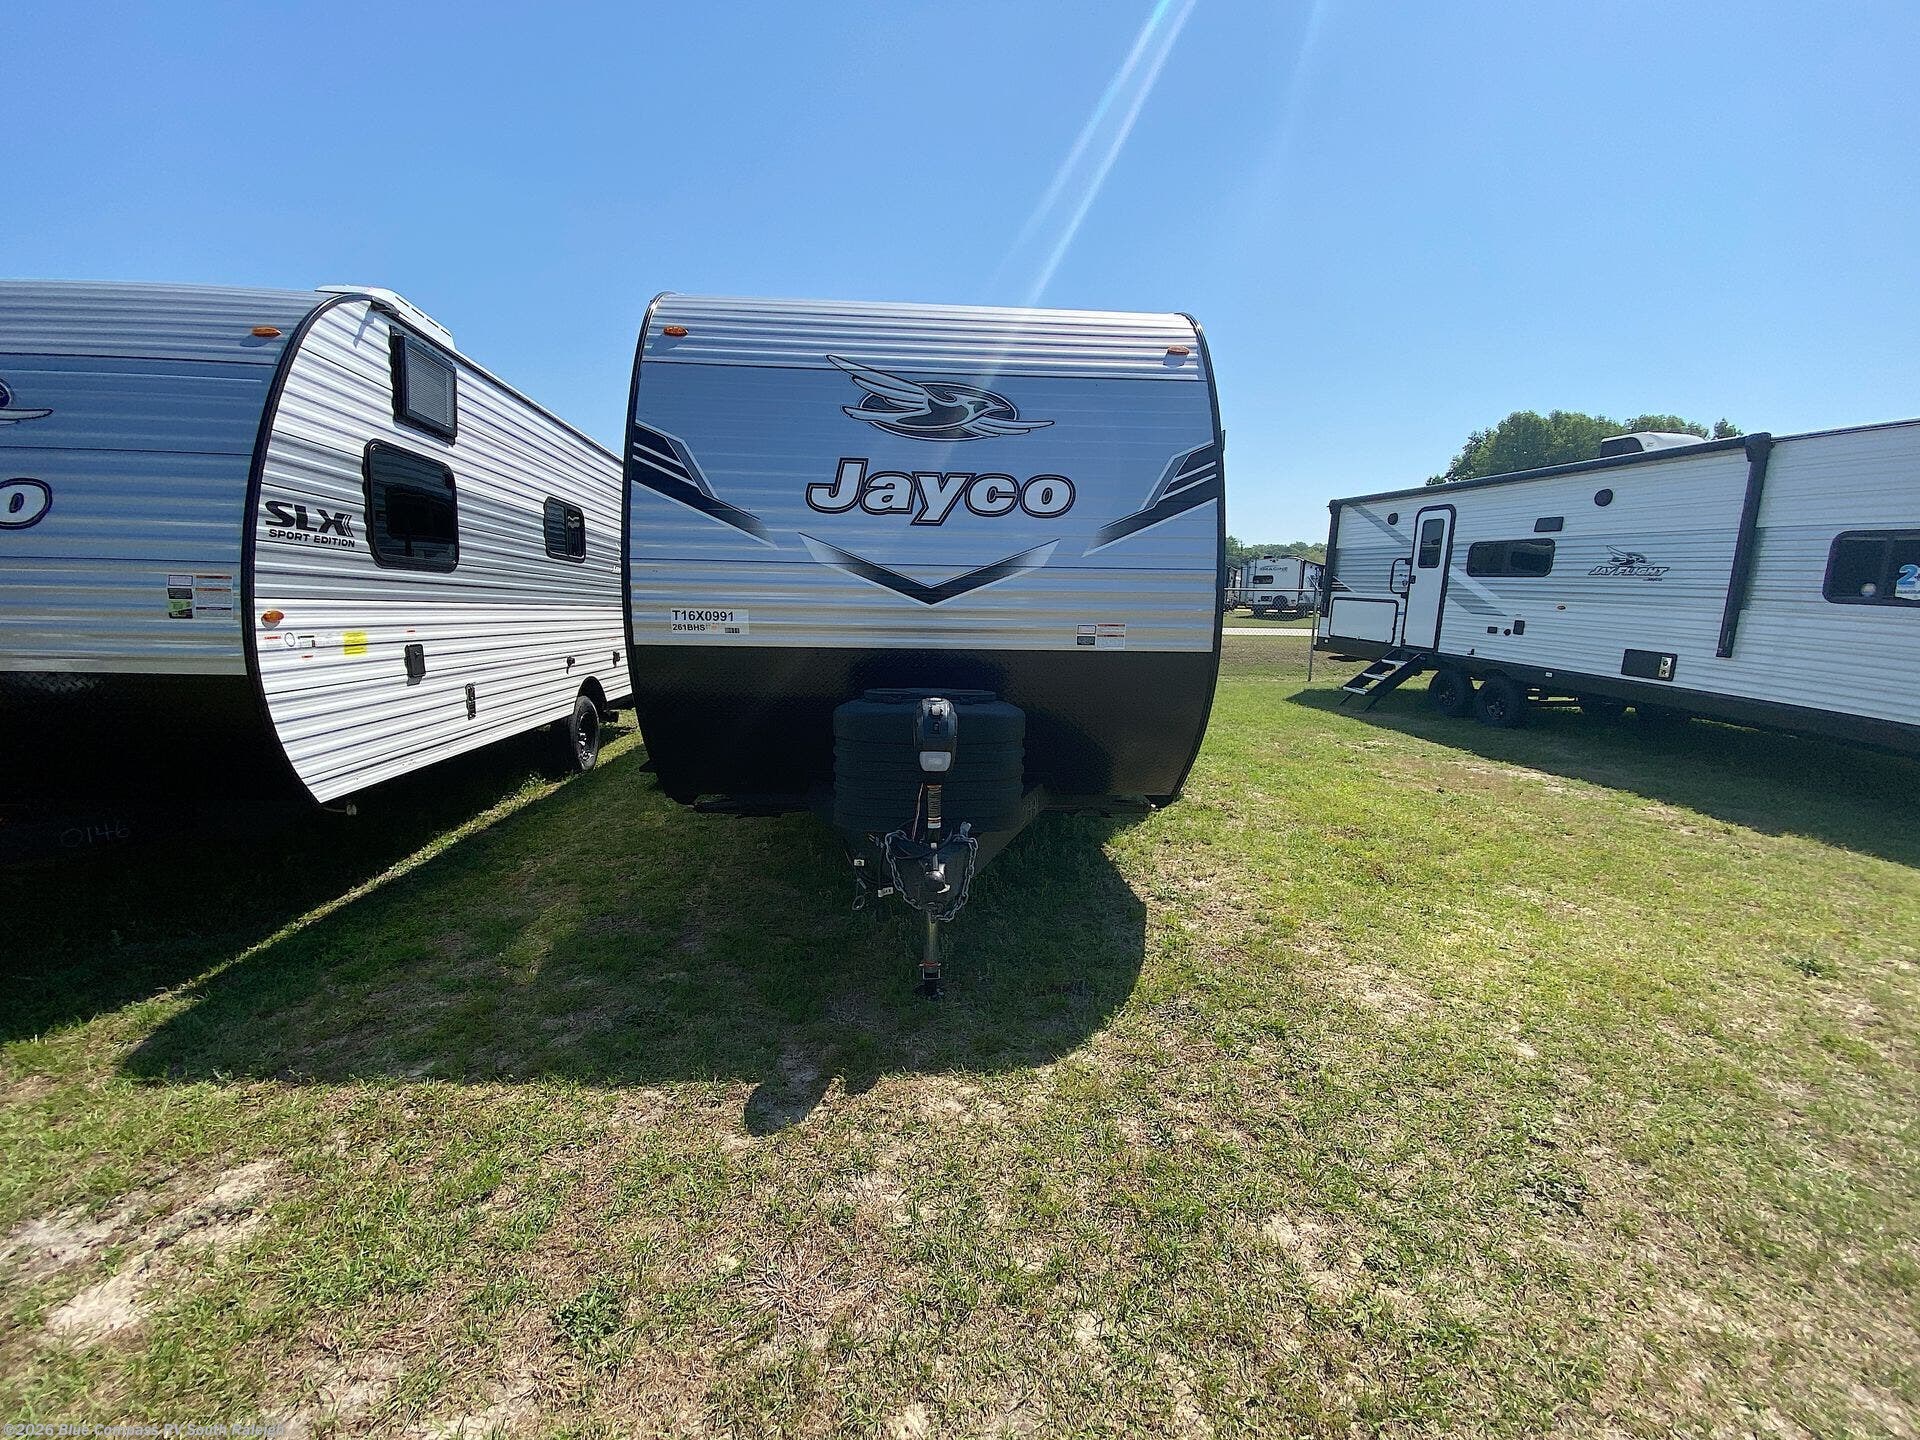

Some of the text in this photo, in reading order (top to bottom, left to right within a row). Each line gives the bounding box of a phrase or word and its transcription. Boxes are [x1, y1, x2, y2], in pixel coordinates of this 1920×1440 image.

[806, 458, 1076, 526] Jayco
[265, 501, 355, 537] SLX
[269, 529, 355, 547] SPORT EDITION
[1588, 565, 1670, 577] JAY FLIGHT
[672, 610, 734, 622] T16X0991
[672, 623, 706, 632] 261BHS
